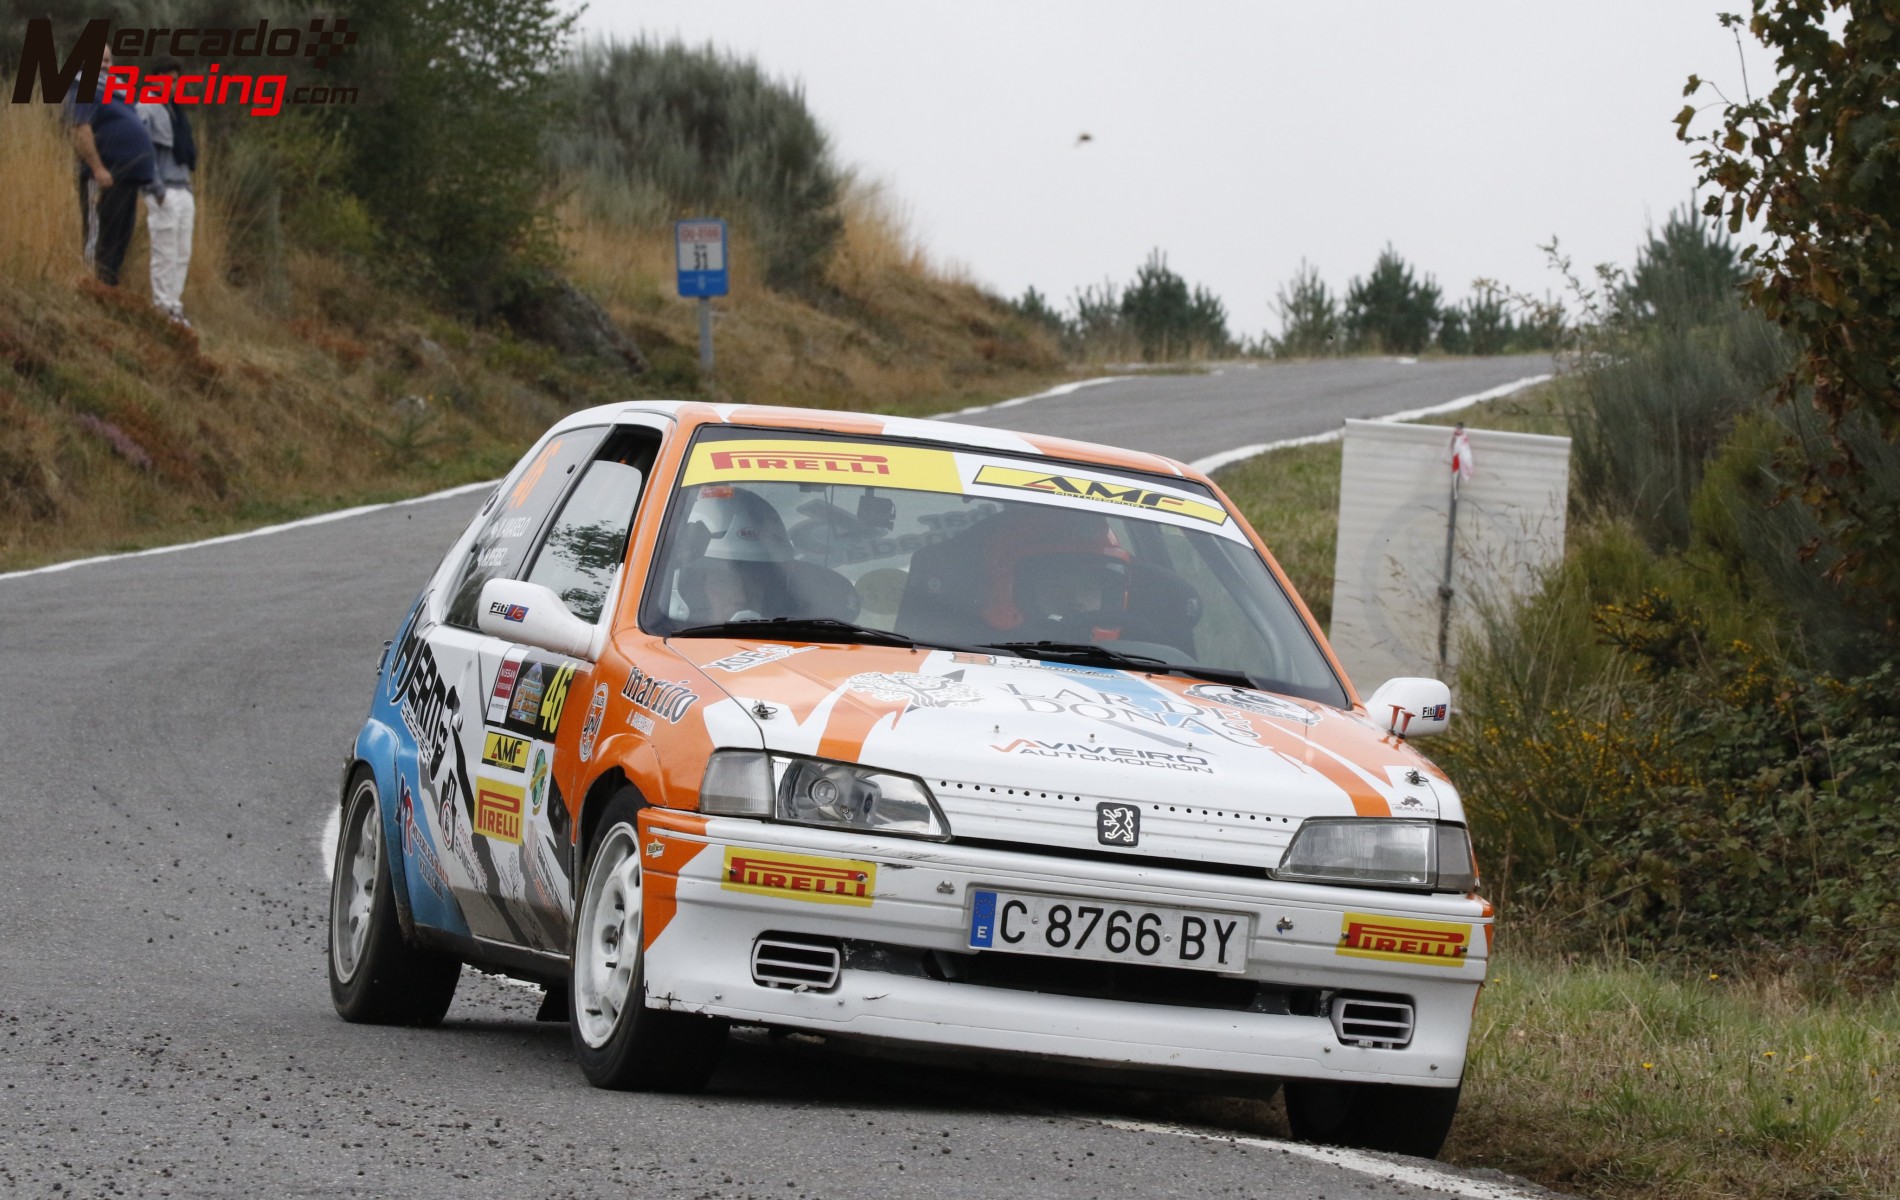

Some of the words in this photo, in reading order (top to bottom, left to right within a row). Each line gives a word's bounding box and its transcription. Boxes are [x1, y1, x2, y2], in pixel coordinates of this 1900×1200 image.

[710, 450, 890, 475] PIRELLI
[1023, 476, 1186, 507] AMF
[490, 601, 509, 613] Fiti
[541, 661, 577, 733] 46
[1018, 697, 1266, 746] DONAS
[490, 735, 523, 764] AMF
[477, 789, 521, 839] PIRELLI
[729, 857, 868, 897] PIRELLI
[976, 926, 988, 939] E
[1000, 900, 1028, 944] C
[1045, 904, 1162, 956] 8766
[1179, 916, 1237, 965] BY
[1345, 922, 1465, 957] PIRELLI
